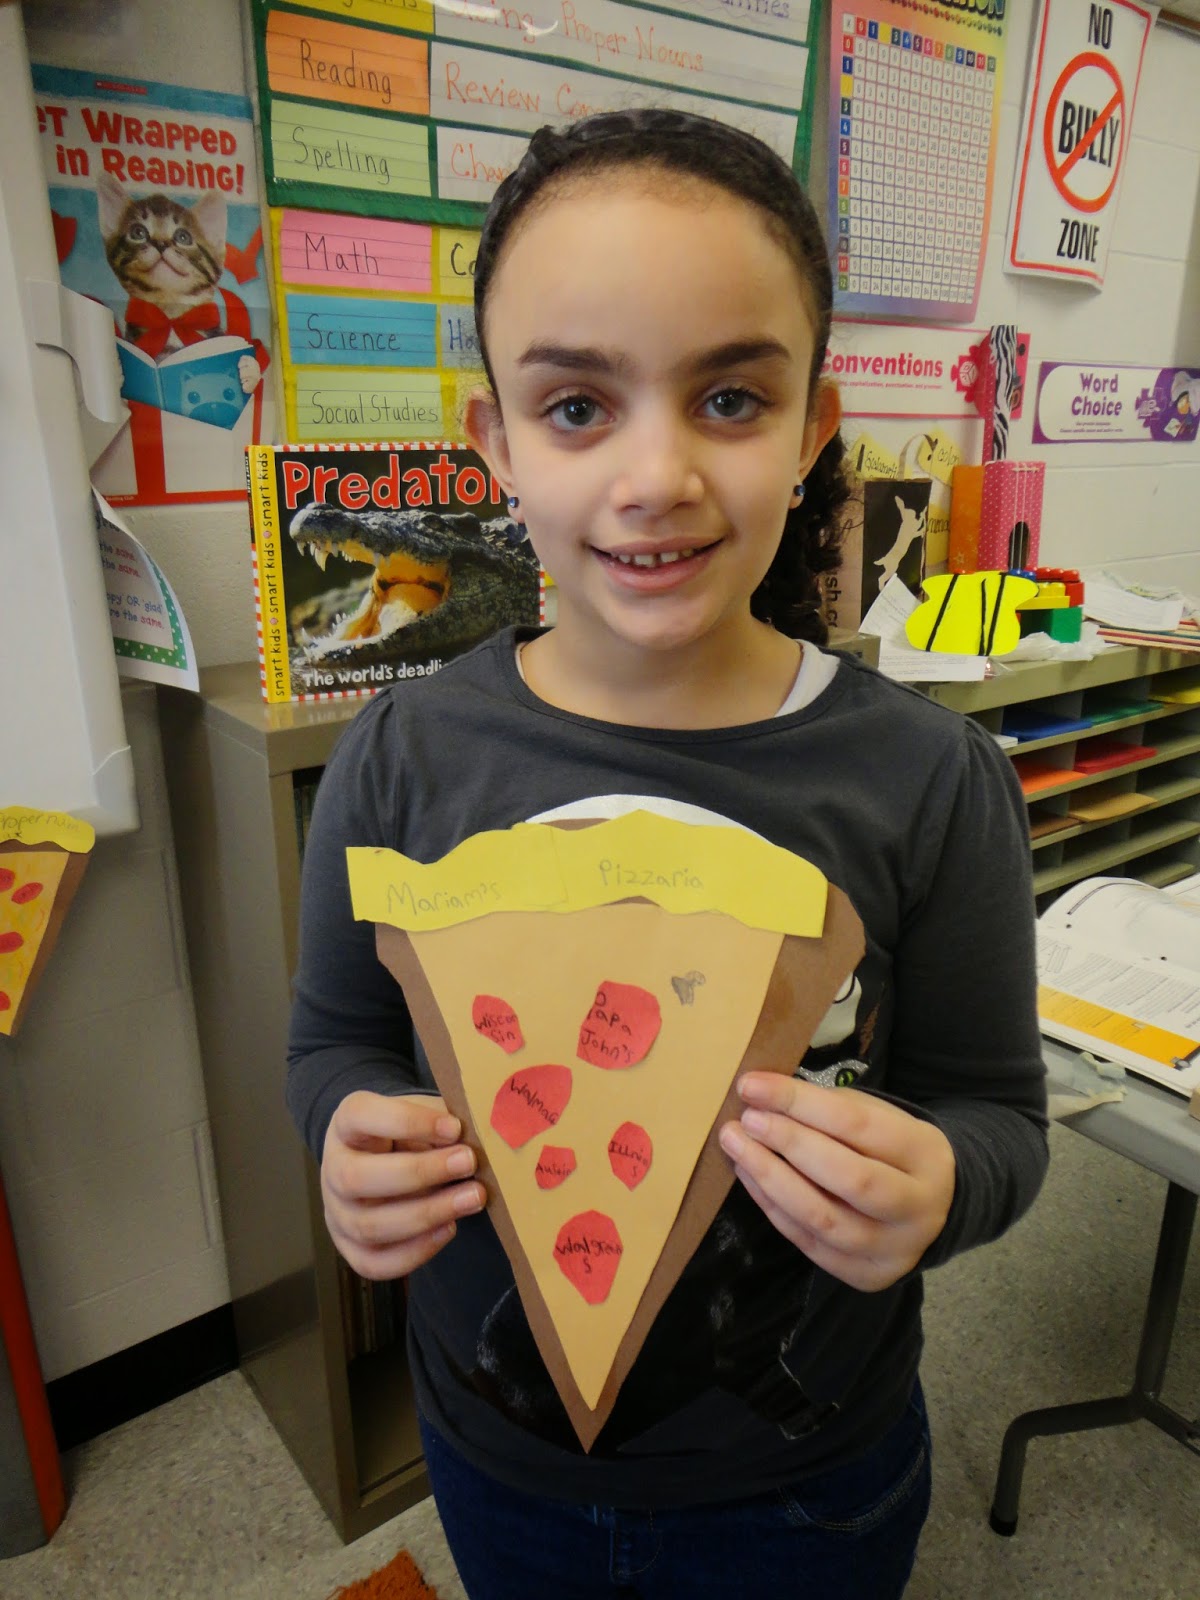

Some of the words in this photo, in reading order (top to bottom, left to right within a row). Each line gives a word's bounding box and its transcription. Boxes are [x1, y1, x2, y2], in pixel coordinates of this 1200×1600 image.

[1088, 3, 1113, 50] NO
[636, 25, 705, 72] Nouns
[300, 38, 393, 104] Reading
[446, 61, 540, 112] Review
[1057, 100, 1121, 168] BULLY
[56, 143, 90, 176] in
[292, 125, 391, 185] Spelling
[304, 233, 380, 276] Math
[1056, 218, 1100, 263] ZONE
[307, 313, 401, 351] Science
[1079, 373, 1119, 393] Word
[311, 391, 366, 424] Social
[369, 391, 439, 424] Studies
[1071, 396, 1123, 416] Choice
[257, 453, 269, 480] kids
[259, 485, 273, 527] smart
[264, 542, 276, 568] kids
[265, 574, 279, 613] smart
[123, 609, 138, 622] the
[270, 628, 281, 653] kids
[272, 658, 285, 696] smart
[302, 670, 334, 687] The
[337, 664, 394, 684] world's
[397, 659, 449, 679] deadli
[387, 881, 502, 916] Mariam's
[598, 859, 704, 890] Pizzaria
[581, 1028, 631, 1063] John's
